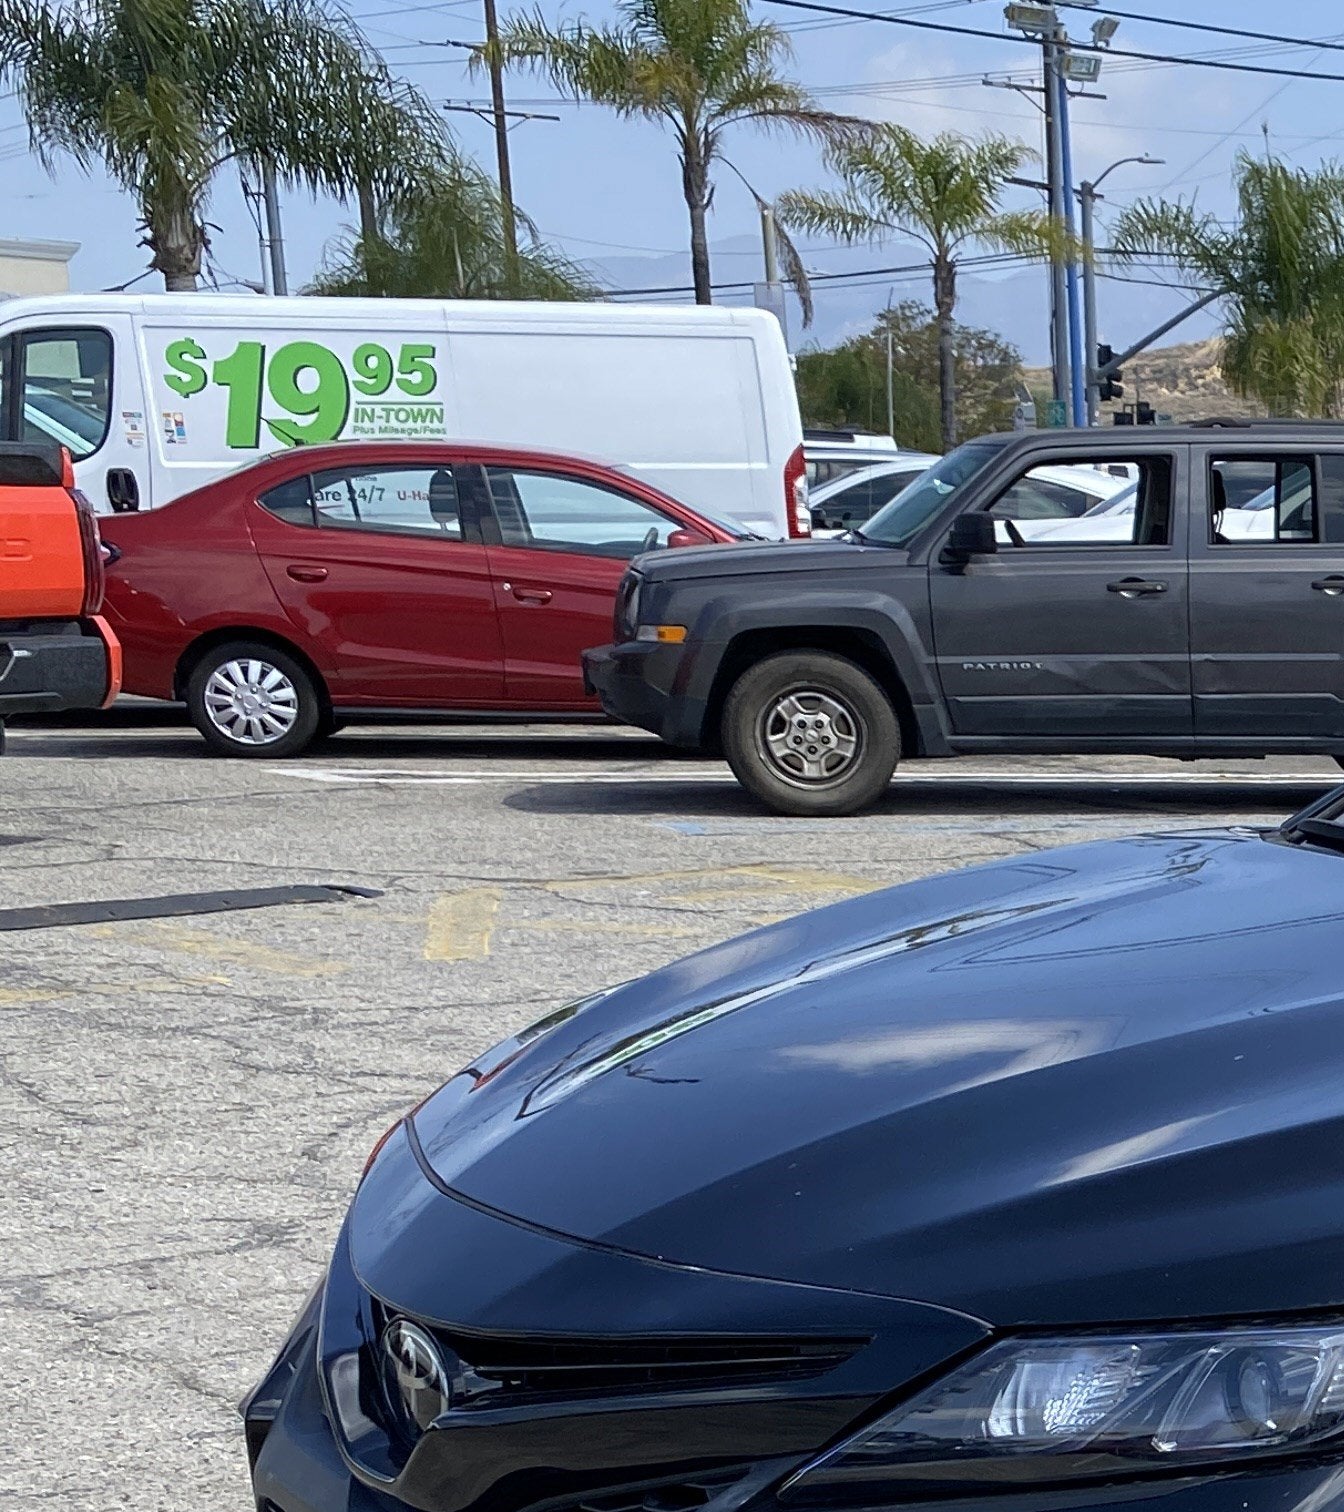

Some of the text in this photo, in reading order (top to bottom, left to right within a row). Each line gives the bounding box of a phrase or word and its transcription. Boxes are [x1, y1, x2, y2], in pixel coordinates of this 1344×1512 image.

[353, 407, 444, 424] IN-TOWN
[352, 425, 376, 435] Plus
[962, 662, 1044, 671] PATRIOT
